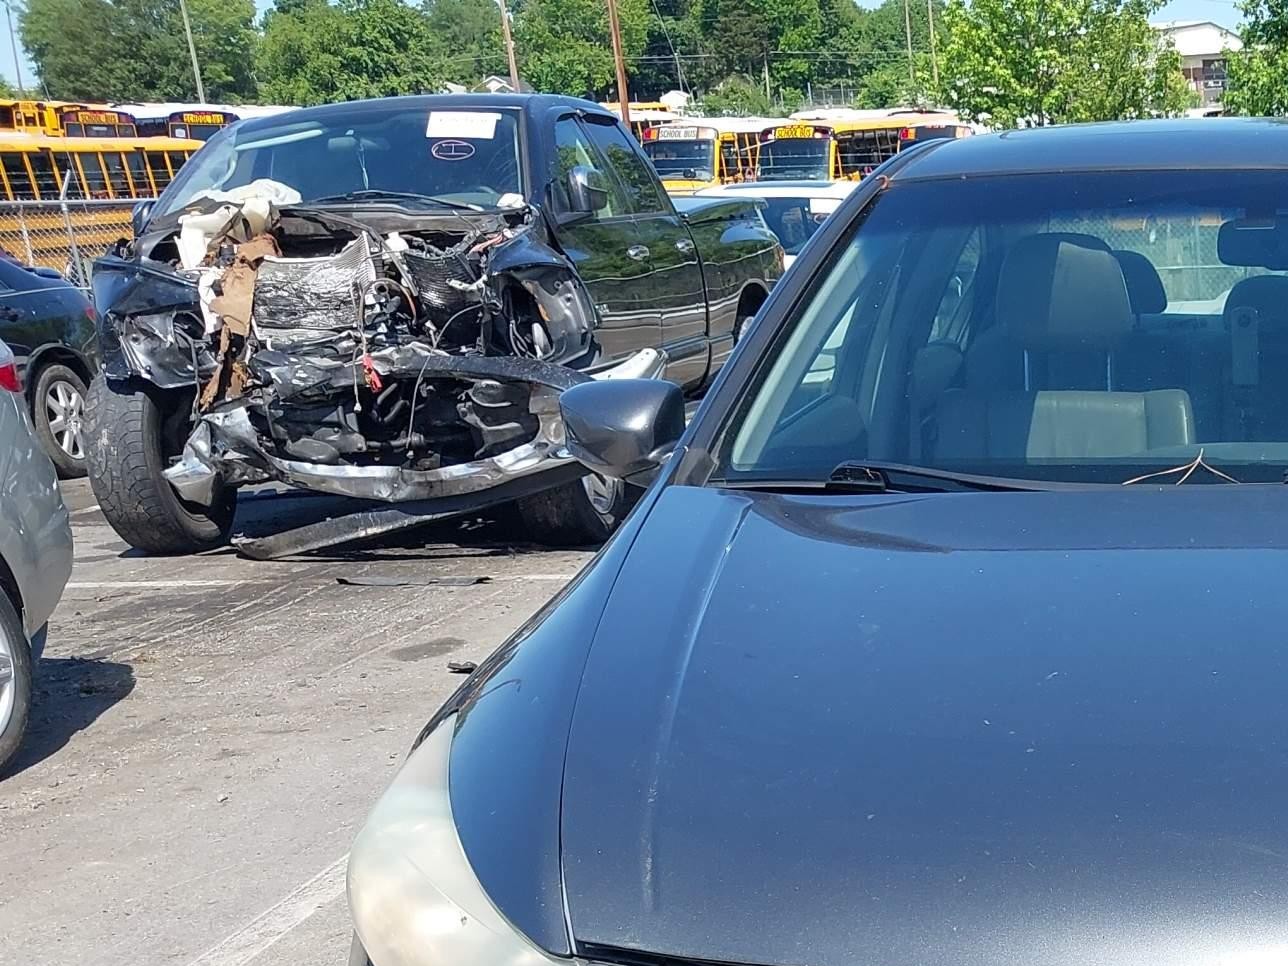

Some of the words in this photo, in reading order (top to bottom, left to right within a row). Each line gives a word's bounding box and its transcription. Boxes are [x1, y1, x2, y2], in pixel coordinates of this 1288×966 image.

[81, 113, 102, 123] SCHOOL
[105, 113, 117, 123] BUS
[185, 114, 207, 124] SCHOOL
[211, 114, 224, 124] BUS
[659, 128, 682, 138] SCHOOL
[683, 129, 696, 138] BUS
[776, 128, 797, 138] SCHOOL
[799, 128, 812, 138] BUS
